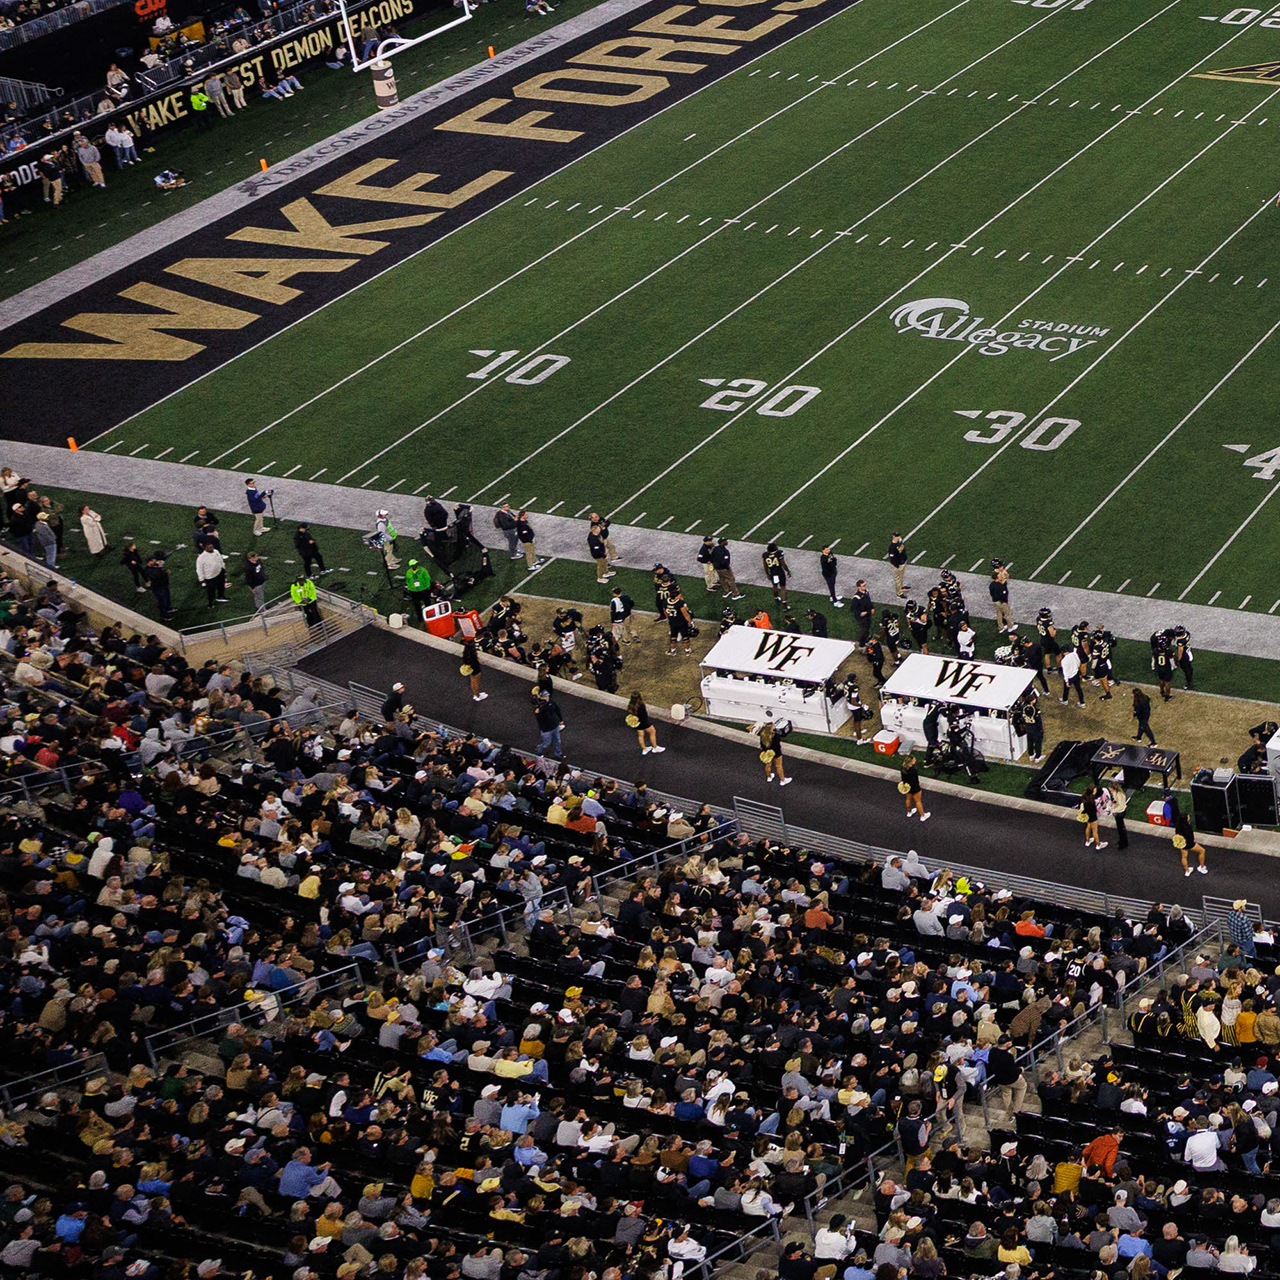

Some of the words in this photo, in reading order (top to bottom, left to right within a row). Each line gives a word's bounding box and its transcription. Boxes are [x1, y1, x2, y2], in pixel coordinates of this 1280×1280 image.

[271, 26, 333, 71] DEMON
[278, 130, 368, 176] DEACON
[362, 104, 420, 138] CLUB
[445, 33, 565, 91] ANNIVERSARY
[0, 157, 515, 362] WAKE
[903, 306, 1099, 362] Allegacy
[1016, 317, 1111, 339] STADIUM
[466, 349, 572, 386] 10
[700, 378, 823, 418] 20
[962, 408, 1082, 453] 30
[753, 631, 815, 672] WF
[934, 658, 996, 699] WF
[877, 743, 886, 753] G
[1145, 754, 1168, 767] WF
[1153, 815, 1162, 824] G
[422, 1089, 439, 1106] WF
[459, 1136, 471, 1151] 2
